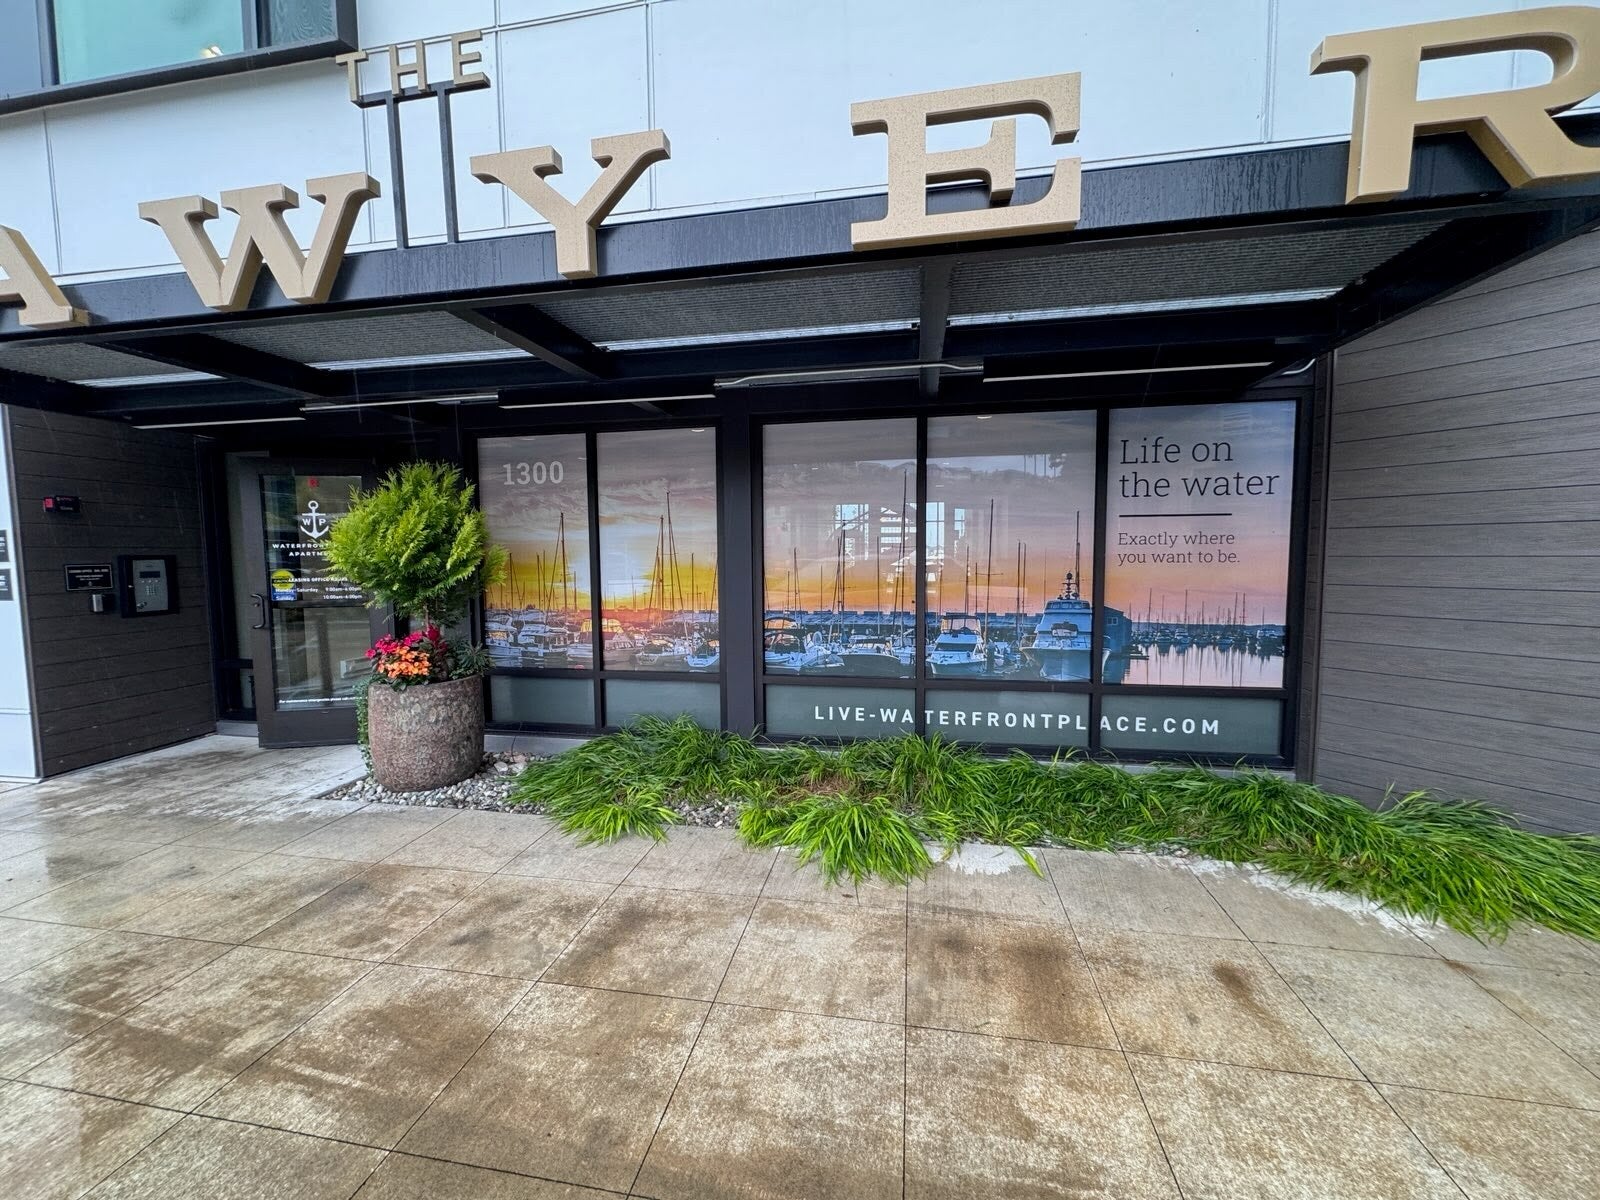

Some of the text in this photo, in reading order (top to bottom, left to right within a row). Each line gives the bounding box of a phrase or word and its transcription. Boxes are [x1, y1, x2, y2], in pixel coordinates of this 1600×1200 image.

[336, 30, 490, 104] THE
[1120, 436, 1234, 464] Life on
[502, 461, 564, 485] 1300
[1119, 471, 1280, 498] the water
[1117, 531, 1236, 548] Exactly where
[1117, 549, 1241, 567] you want to be.
[814, 705, 1220, 736] LIVE-WATERFRONTPLACE.COM
